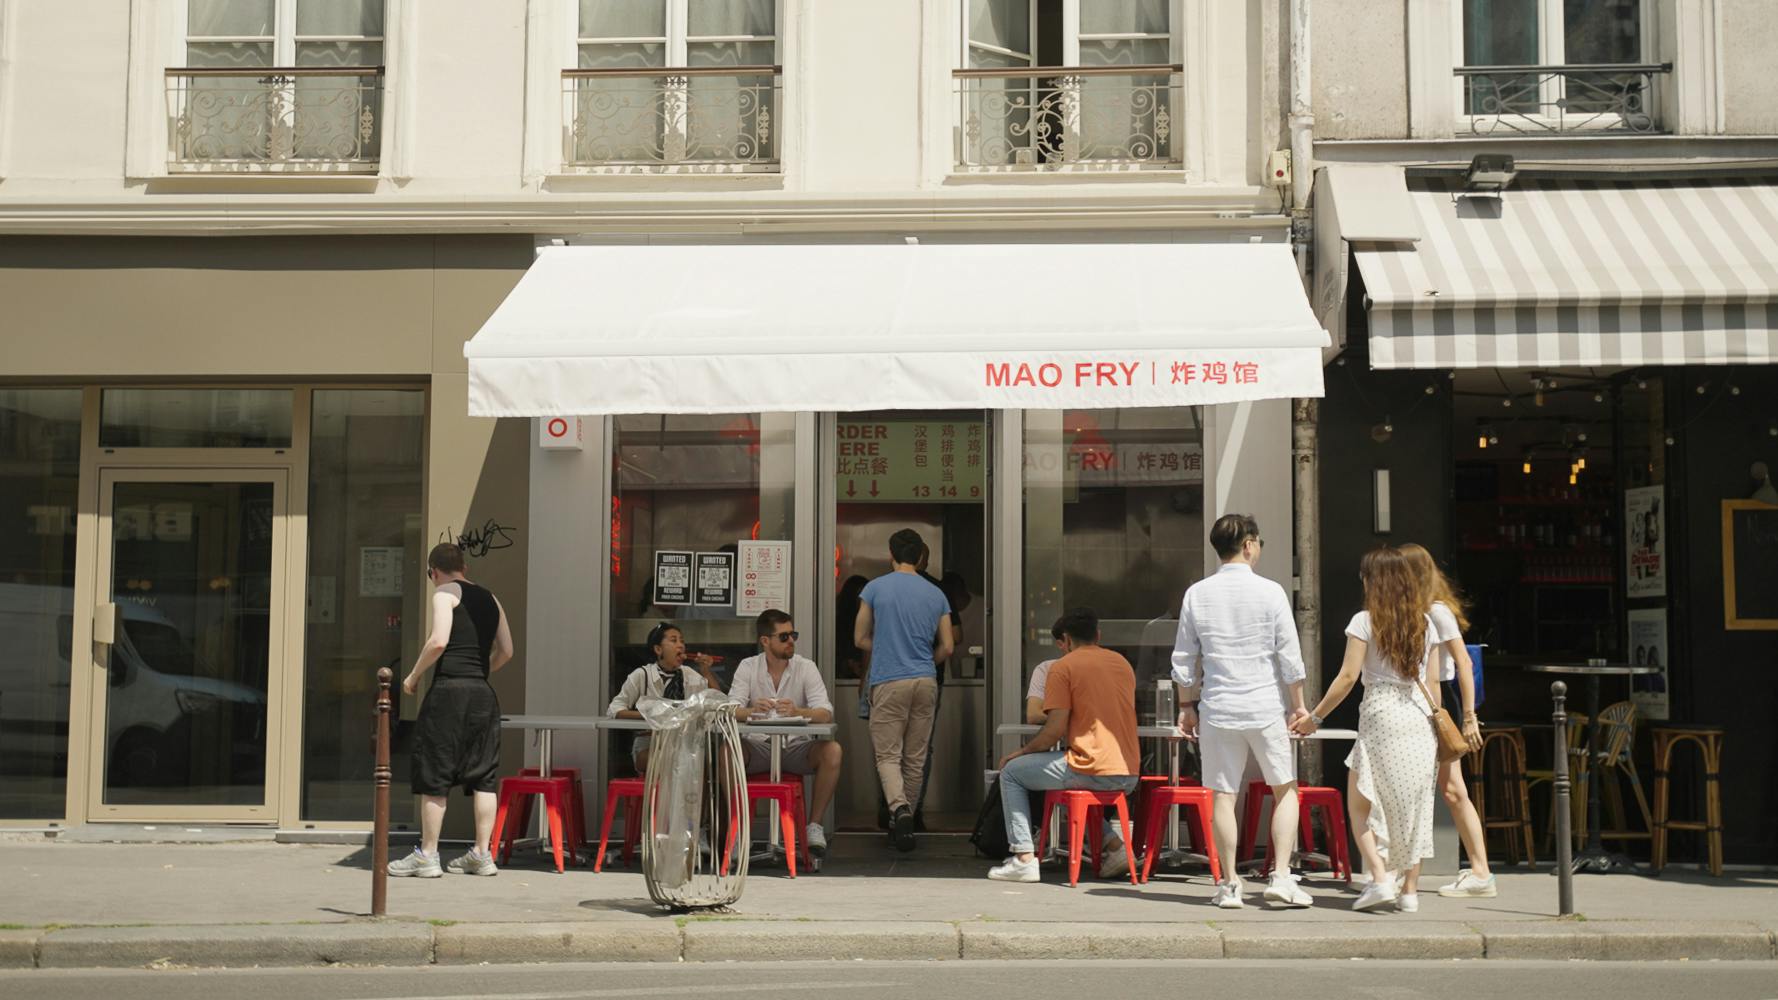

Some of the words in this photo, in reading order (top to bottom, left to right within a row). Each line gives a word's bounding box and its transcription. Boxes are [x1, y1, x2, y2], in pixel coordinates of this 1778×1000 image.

[985, 362, 1063, 388] MAO
[1075, 362, 1139, 387] FRY
[1171, 361, 1259, 385] 炸鸡馆
[914, 424, 928, 467] 汉堡包
[941, 424, 954, 482] 鸡排便当
[968, 424, 981, 467] 炸鸡排
[1067, 452, 1113, 471] FRY
[1136, 451, 1202, 471] 炸鸡馆
[912, 485, 930, 497] 13
[939, 485, 957, 497] 14
[970, 485, 980, 497] 9
[662, 555, 686, 563] WANTED
[703, 556, 726, 564] WANTED
